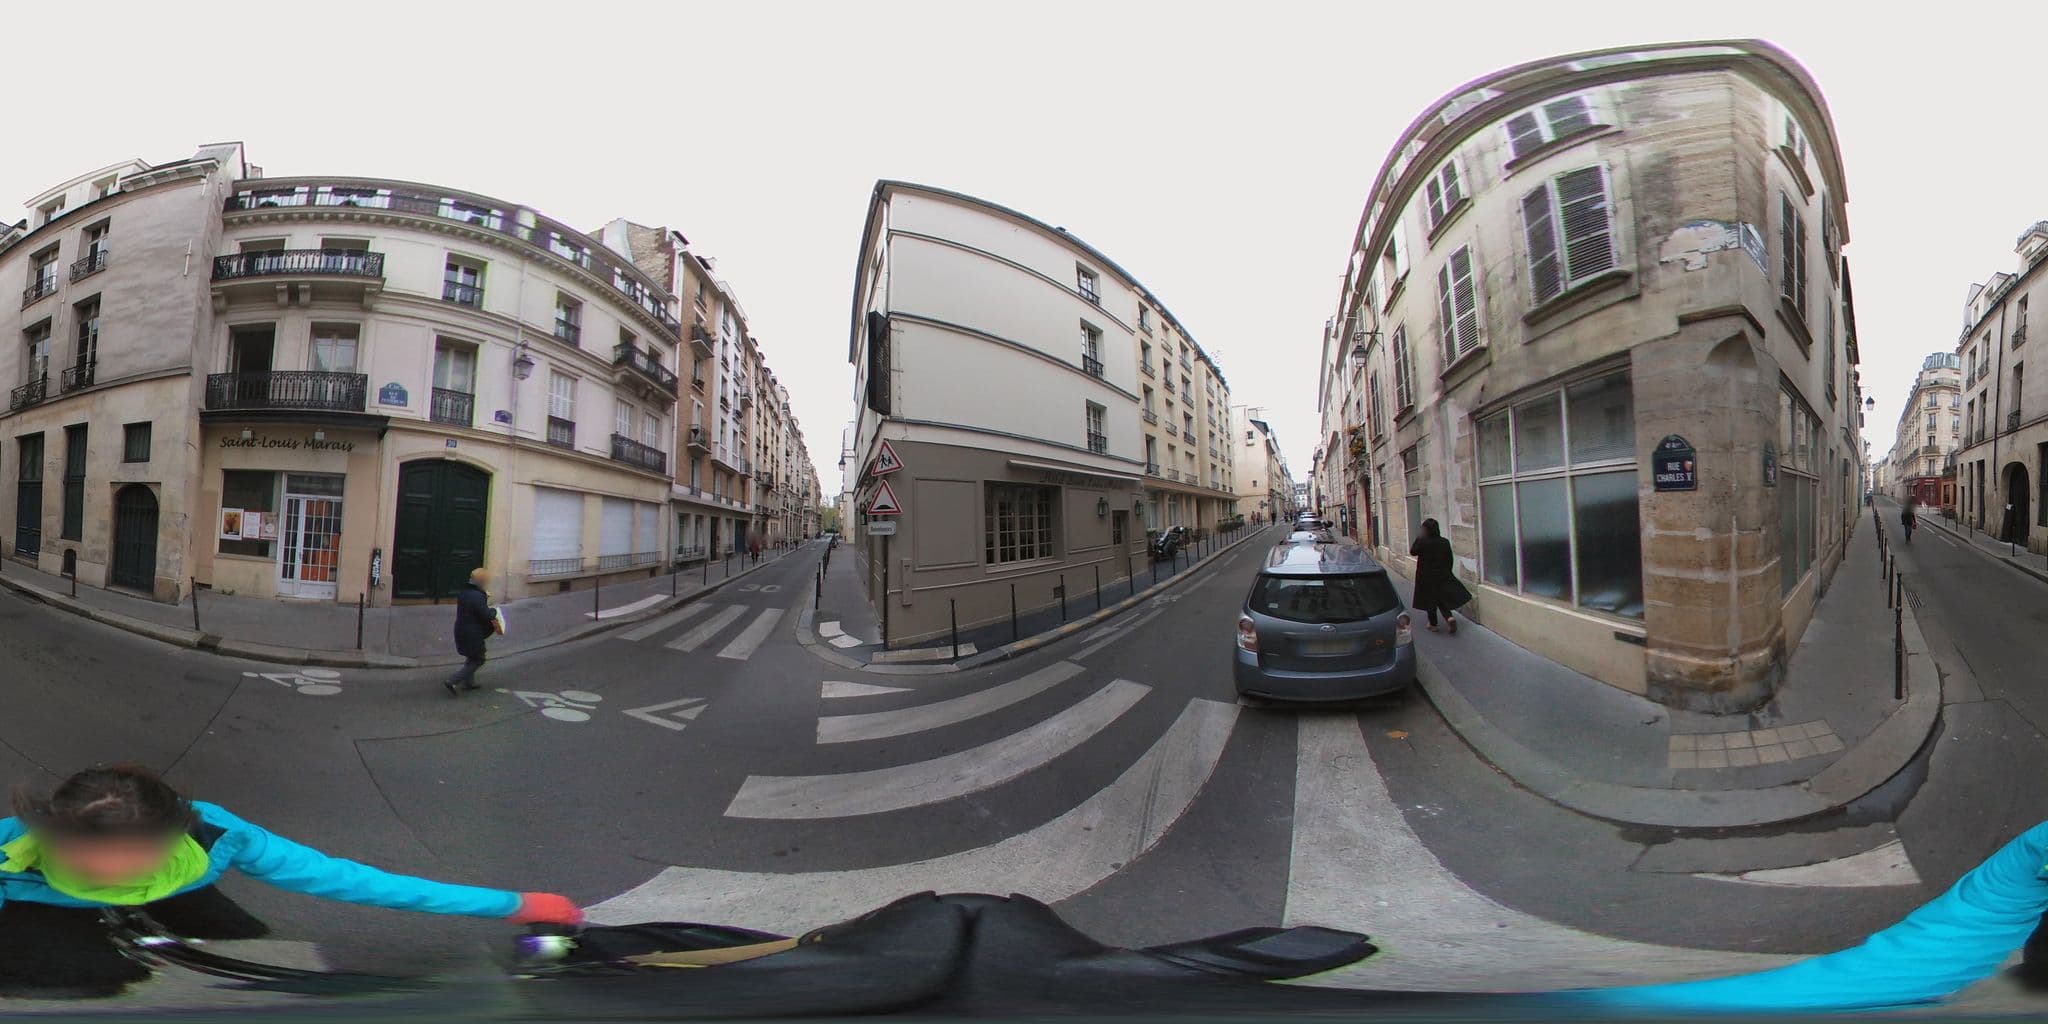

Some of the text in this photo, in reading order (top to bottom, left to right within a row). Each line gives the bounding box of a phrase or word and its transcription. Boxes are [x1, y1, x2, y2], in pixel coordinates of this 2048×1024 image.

[220, 436, 354, 452] Saint-Louis Marais
[1667, 461, 1680, 471] RUE
[1656, 472, 1692, 482] CHARLES V
